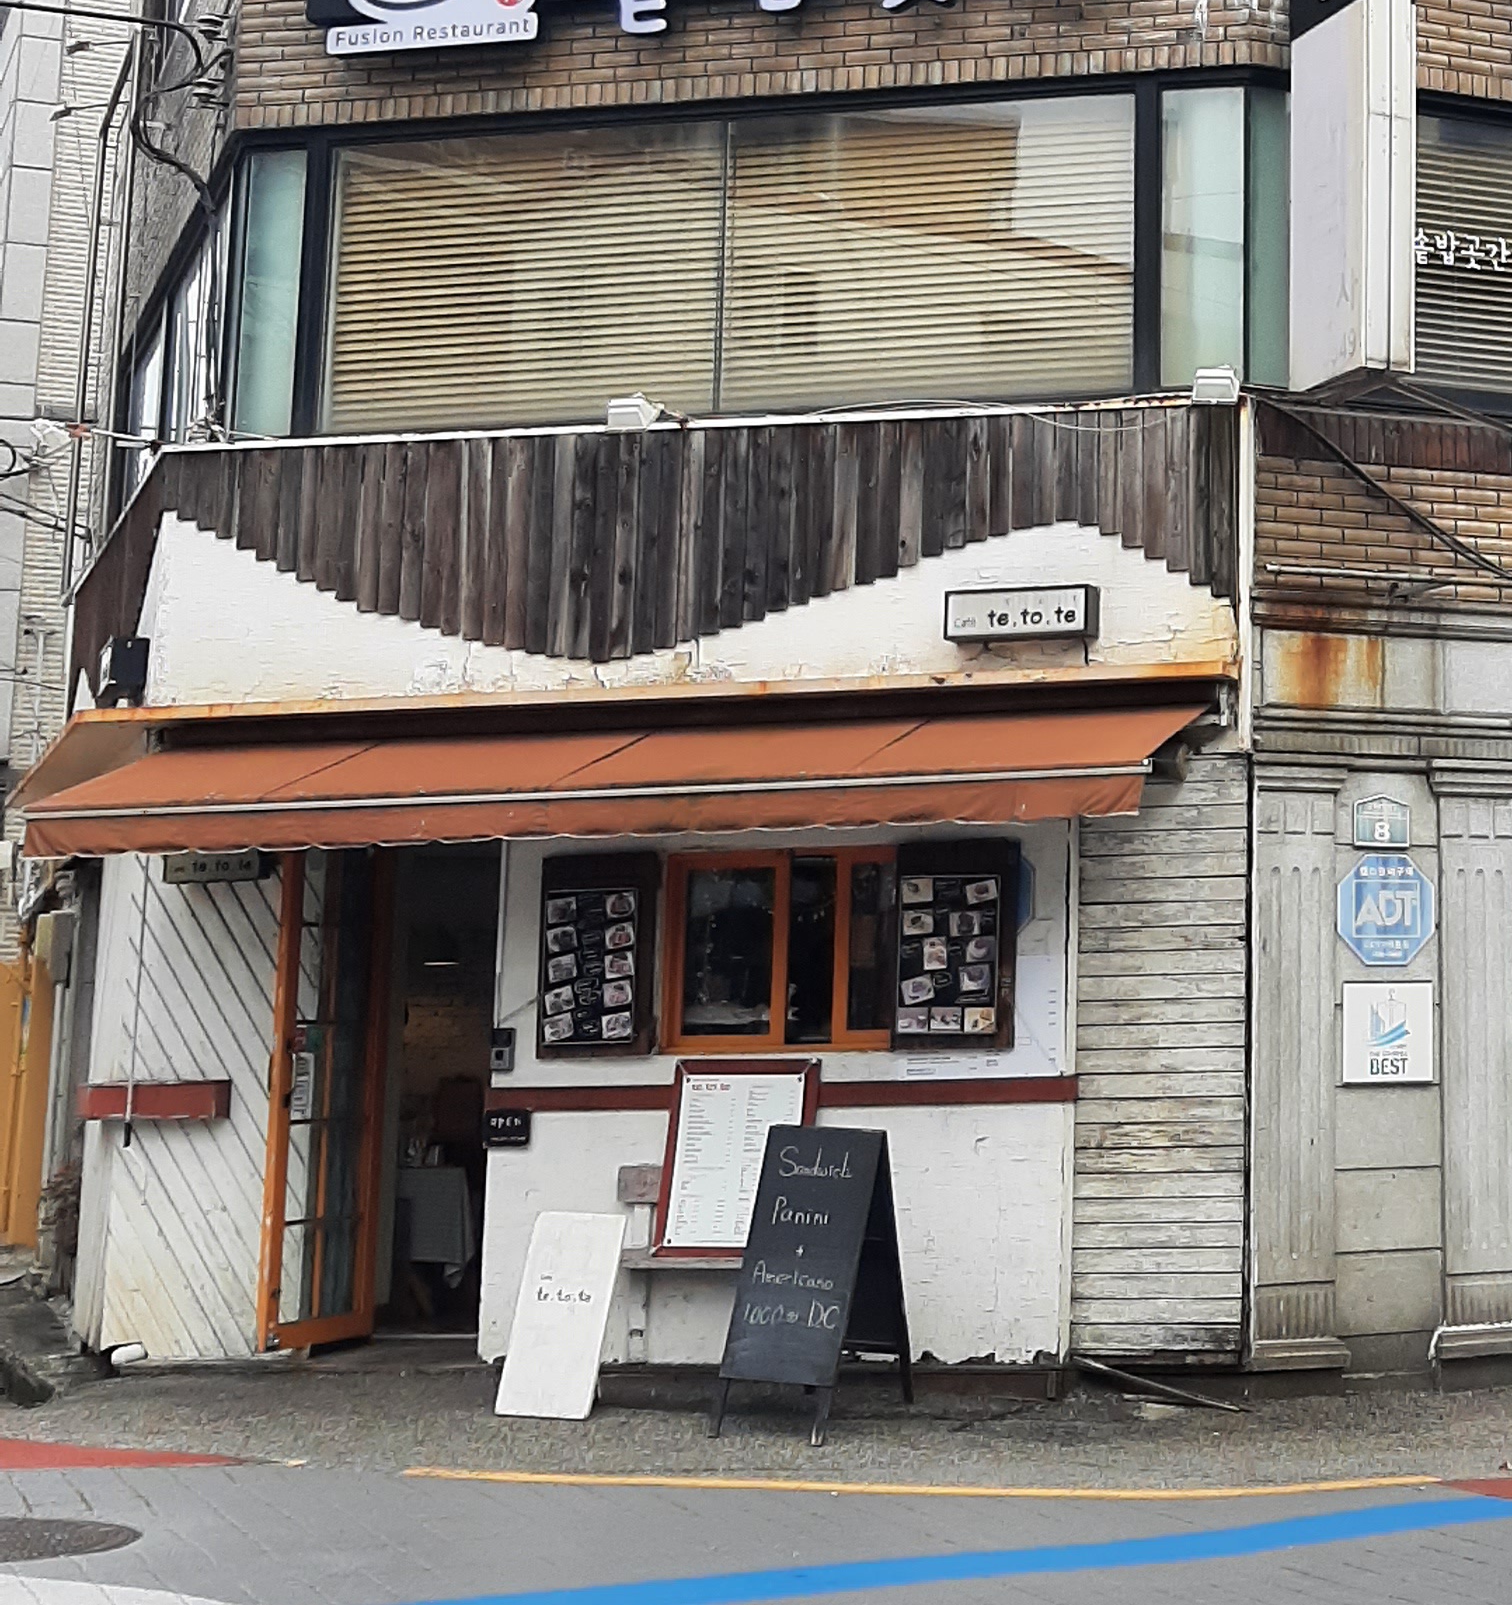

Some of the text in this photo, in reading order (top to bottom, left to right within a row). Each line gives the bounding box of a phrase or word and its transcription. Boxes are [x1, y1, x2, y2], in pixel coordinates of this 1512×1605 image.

[335, 17, 532, 48] Fusion Restaurant
[1414, 227, 1512, 272] 솥밥곳간
[1355, 890, 1417, 927] ADT
[1370, 1057, 1409, 1075] BEST
[771, 1196, 829, 1226] Panini
[807, 1299, 841, 1330] DC
